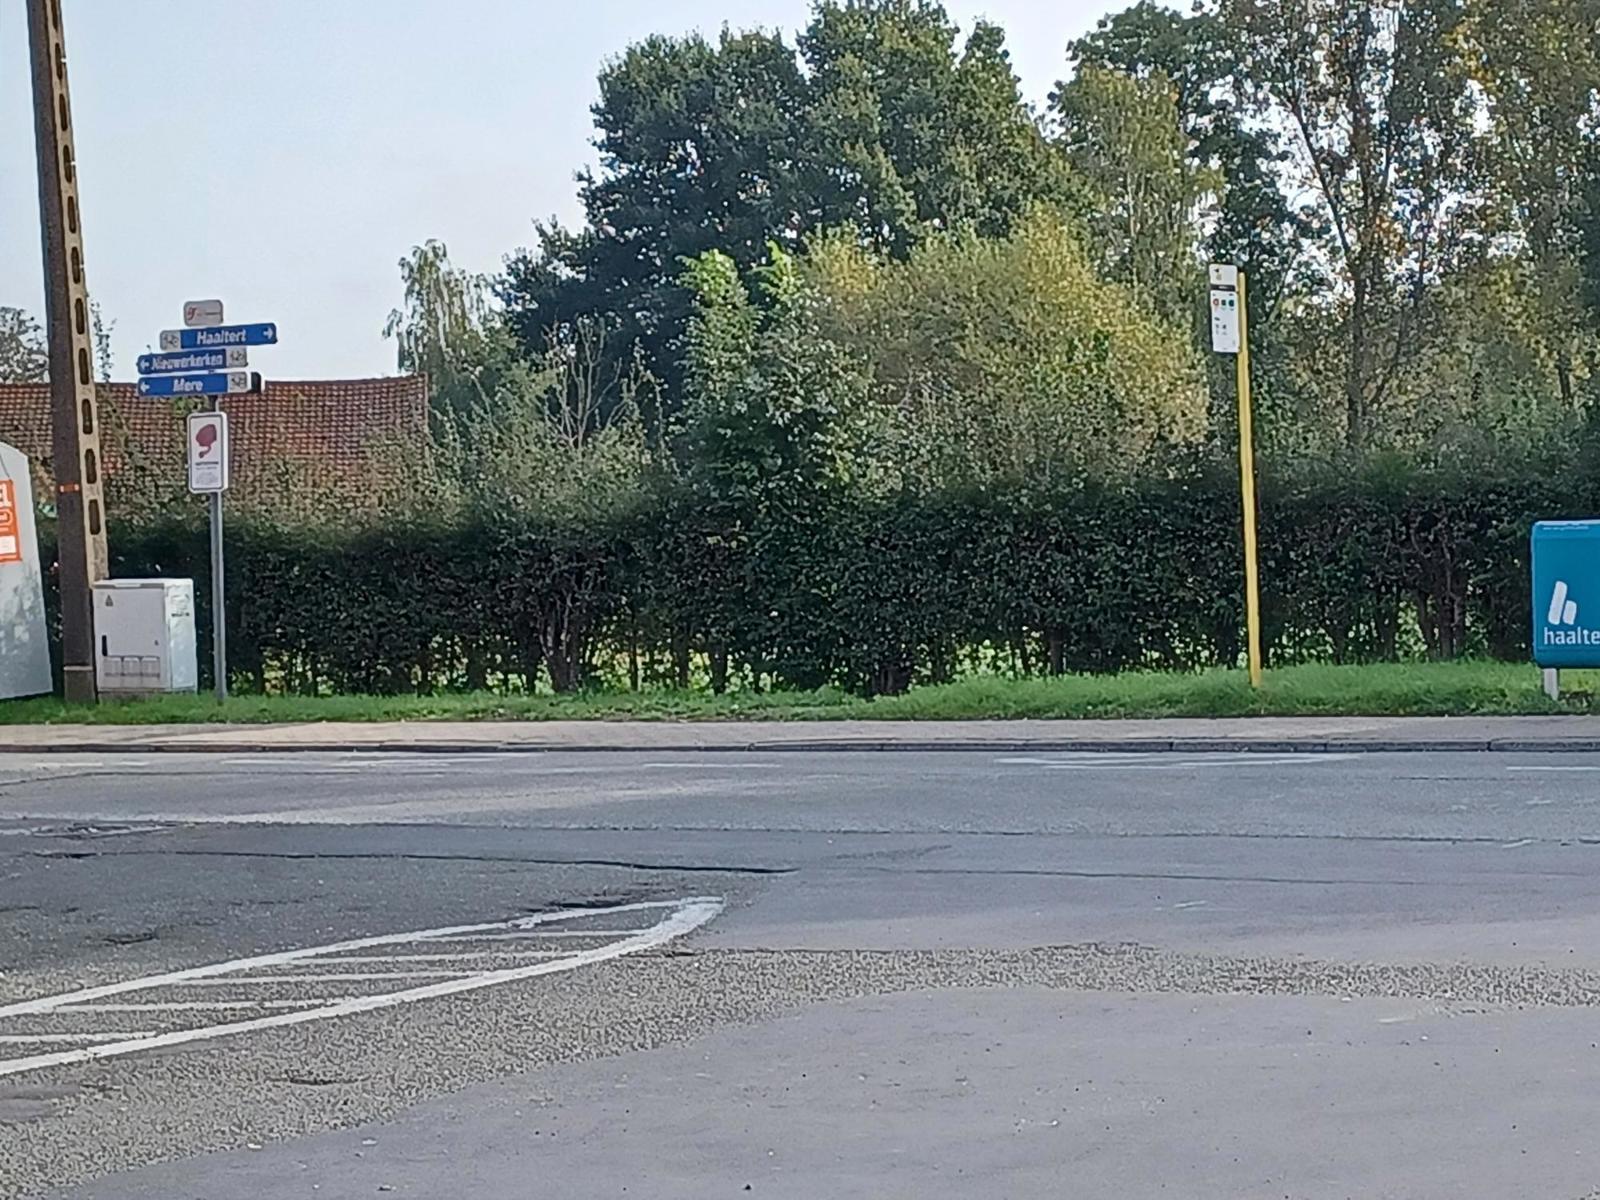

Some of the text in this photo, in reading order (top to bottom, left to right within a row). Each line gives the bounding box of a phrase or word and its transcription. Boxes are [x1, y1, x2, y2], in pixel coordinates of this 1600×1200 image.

[196, 329, 247, 345] Haaltert
[151, 353, 223, 370] Nieuwerkerken
[173, 378, 203, 392] Mere
